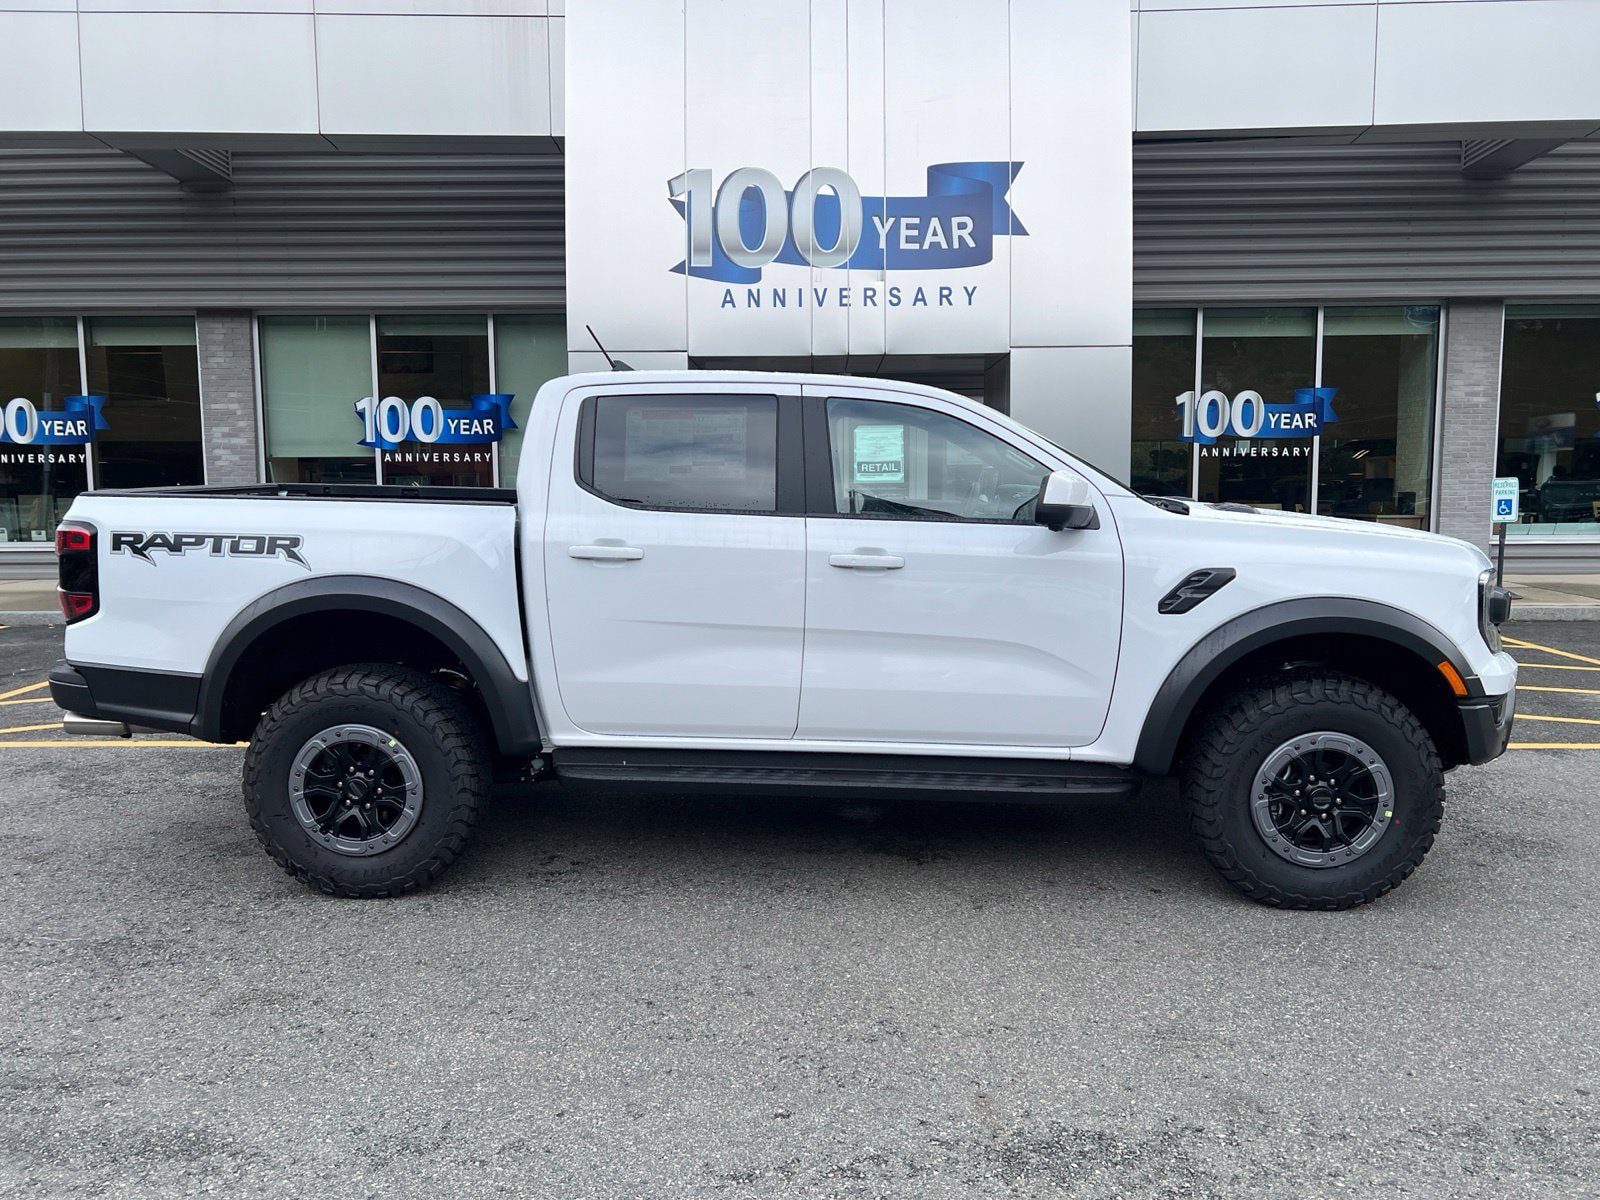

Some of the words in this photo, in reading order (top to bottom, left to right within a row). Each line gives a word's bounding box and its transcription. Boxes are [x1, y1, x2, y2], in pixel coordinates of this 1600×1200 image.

[667, 166, 863, 269] 100
[871, 216, 977, 250] YEAR
[720, 285, 979, 308] ANNIVERSARY
[0, 397, 38, 444] 0
[41, 419, 88, 436] YEAR
[354, 396, 444, 443] 100
[447, 418, 495, 435] YEAR
[1175, 389, 1265, 438] 100
[1268, 412, 1318, 429] YEAR
[384, 452, 492, 463] ANNIVERSARY
[861, 463, 898, 472] RETAIL
[1200, 447, 1311, 457] ANNIVERSARY
[110, 530, 312, 572] RAPTOR
